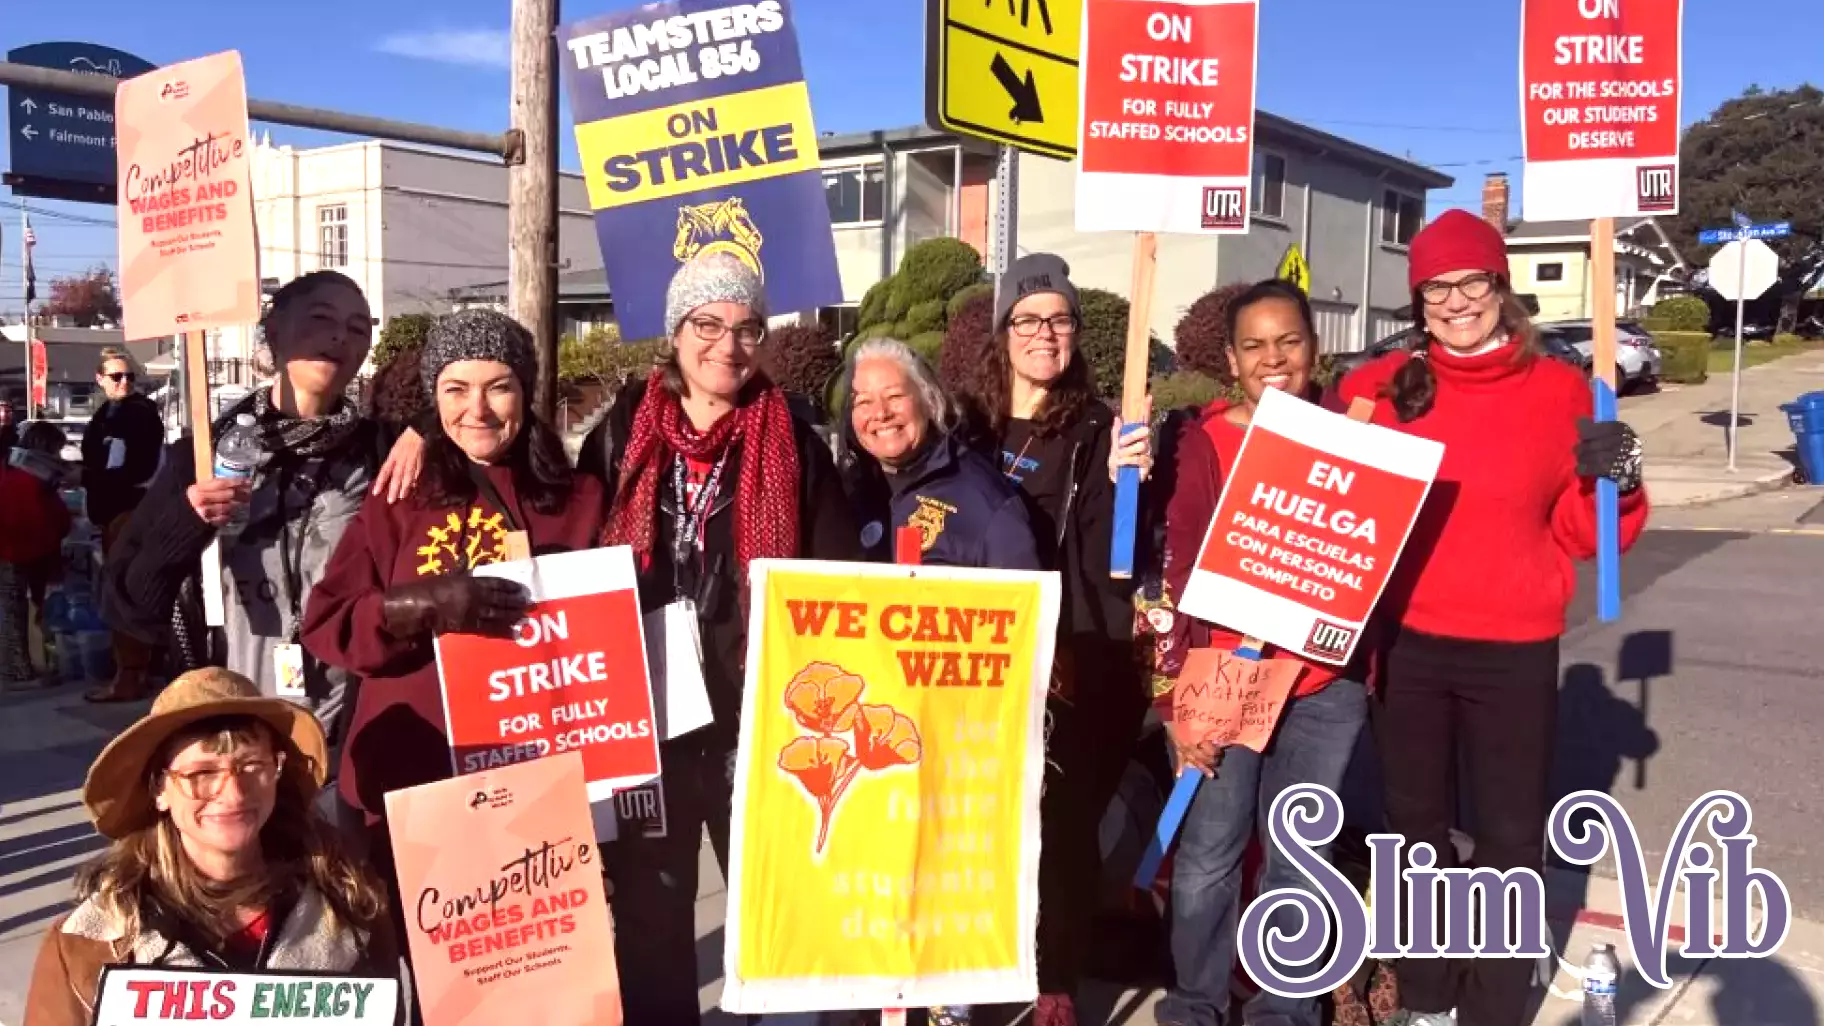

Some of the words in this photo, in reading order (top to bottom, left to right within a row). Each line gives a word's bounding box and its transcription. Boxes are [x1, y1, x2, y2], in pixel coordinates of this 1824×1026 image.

[1576, 0, 1620, 19] ON
[567, 0, 784, 69] TEAMSTERS
[1146, 12, 1191, 43] ON
[1554, 35, 1643, 64] STRIKE
[601, 51, 699, 100] LOCAL
[698, 40, 761, 79] 856
[1119, 54, 1219, 86] STRIKE
[1530, 83, 1563, 100] FOR
[1566, 81, 1596, 98] THE
[1600, 79, 1674, 98] SCHOOLS
[48, 102, 73, 117] San
[78, 107, 114, 123] Pablo
[667, 107, 718, 138] ON
[1122, 98, 1157, 116] FOR
[1165, 102, 1213, 120] FULLY
[1543, 107, 1579, 126] OUR
[1584, 105, 1657, 124] STUDENTS
[49, 128, 105, 147] Fairmont
[1089, 121, 1160, 141] STAFFED
[1164, 125, 1247, 143] SCHOOLS
[1568, 131, 1634, 149] DESERVE
[124, 131, 242, 205] Competitive
[603, 123, 798, 192] STRIKE
[129, 187, 191, 215] WAGES
[196, 179, 238, 202] AND
[1640, 169, 1671, 198] UTR
[142, 202, 228, 233] BENEFITS
[1206, 188, 1242, 217] UTR
[1306, 460, 1356, 495] EN
[1250, 482, 1377, 544] HUELGA
[1232, 511, 1281, 539] PARA
[1284, 530, 1375, 571] ESCUELAS
[1226, 531, 1269, 556] CON
[1270, 548, 1363, 590] PERSONAL
[1239, 557, 1336, 602] COMPLETO
[511, 610, 568, 647] ON
[786, 600, 868, 639] WE
[879, 604, 1016, 644] CAN'T
[1312, 622, 1351, 652] UTR
[488, 651, 608, 702] STRIKE
[896, 650, 1011, 688] WAIT
[1215, 652, 1271, 685] Kids
[1179, 682, 1261, 702] Matter
[499, 712, 543, 738] FOR
[551, 698, 609, 727] FULLY
[464, 737, 550, 773] STAFFED
[555, 719, 651, 752] SCHOOLS
[945, 748, 1001, 780] the
[618, 789, 658, 821] UTR
[416, 836, 593, 934] Competitive
[831, 866, 995, 900] students
[428, 903, 524, 946] WAGES
[531, 888, 588, 918] AND
[448, 913, 577, 963] BENEFITS
[464, 960, 503, 978] Support
[504, 955, 523, 966] Our
[477, 971, 501, 986] Staff
[503, 967, 521, 979] Our
[524, 957, 562, 973] Schools
[126, 979, 237, 1020] THIS
[250, 981, 374, 1019] ENERGY
